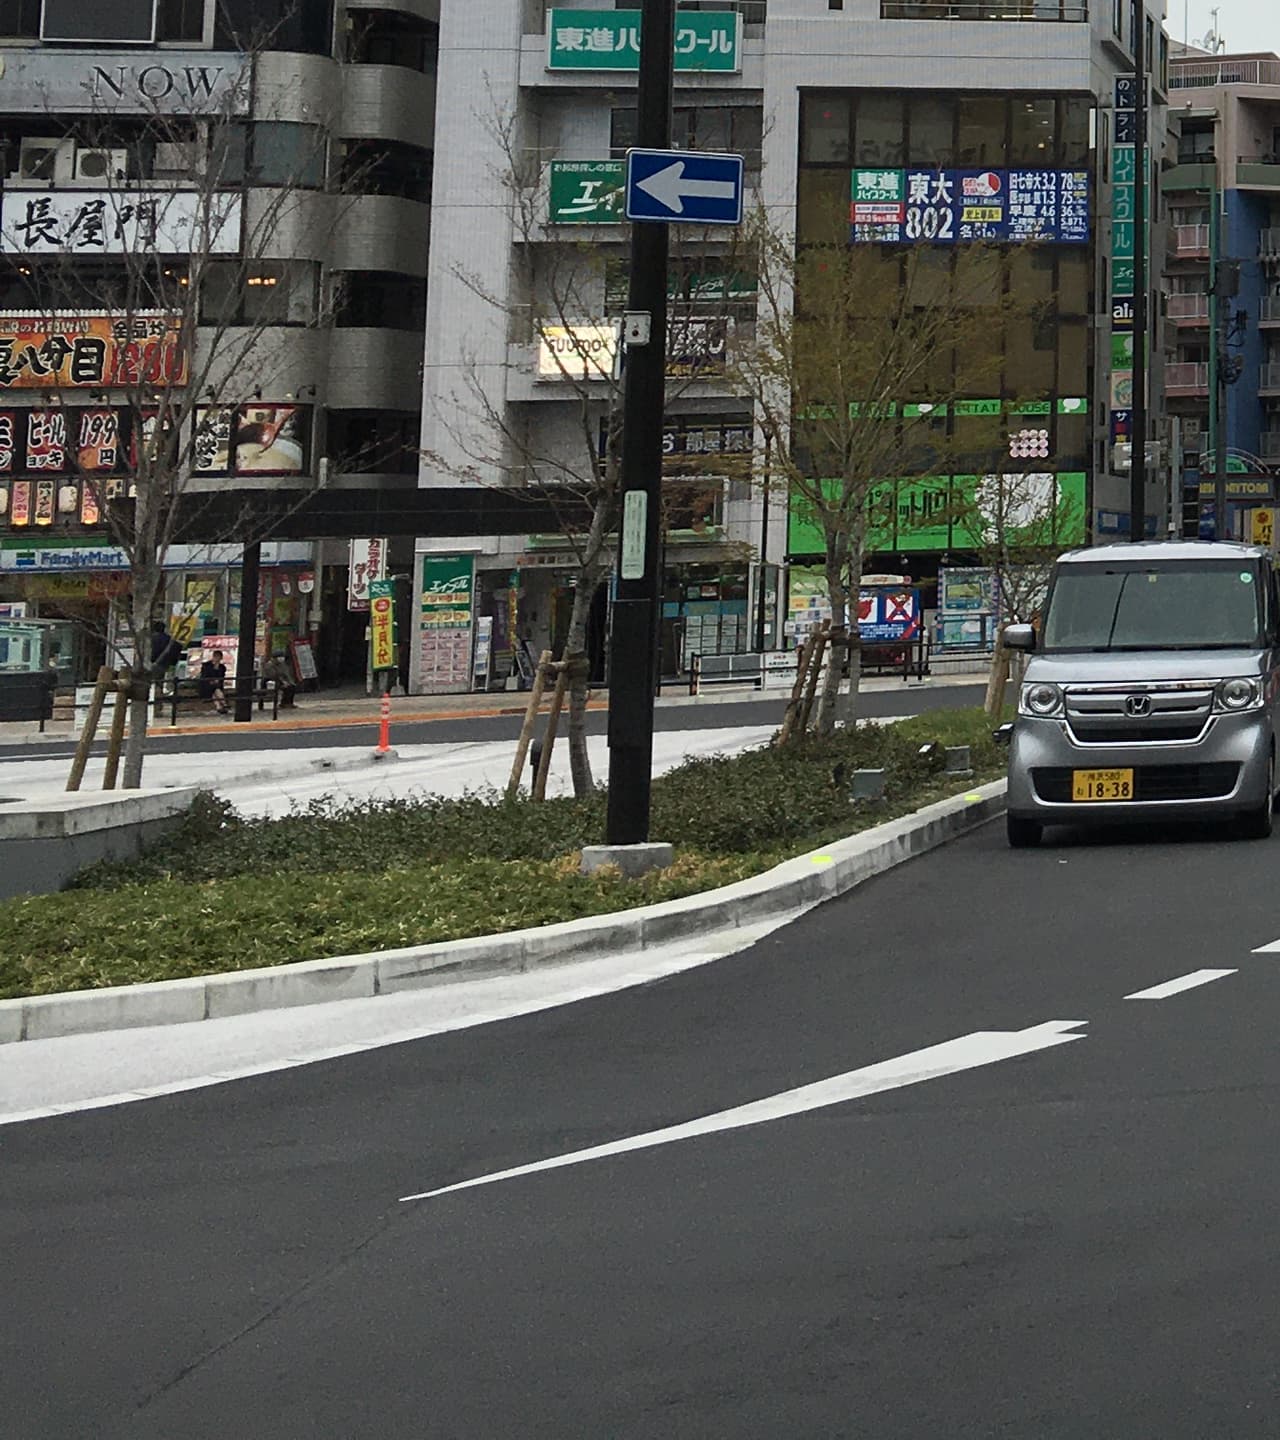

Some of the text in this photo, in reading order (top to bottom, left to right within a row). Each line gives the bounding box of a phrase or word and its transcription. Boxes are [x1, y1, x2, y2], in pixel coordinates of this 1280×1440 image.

[555, 27, 733, 54] 東進ハクール
[92, 66, 224, 100] NOW
[857, 172, 899, 190] 東進
[908, 172, 953, 204] 東大
[905, 206, 954, 239] 802
[1087, 782, 1130, 798] 18-38
